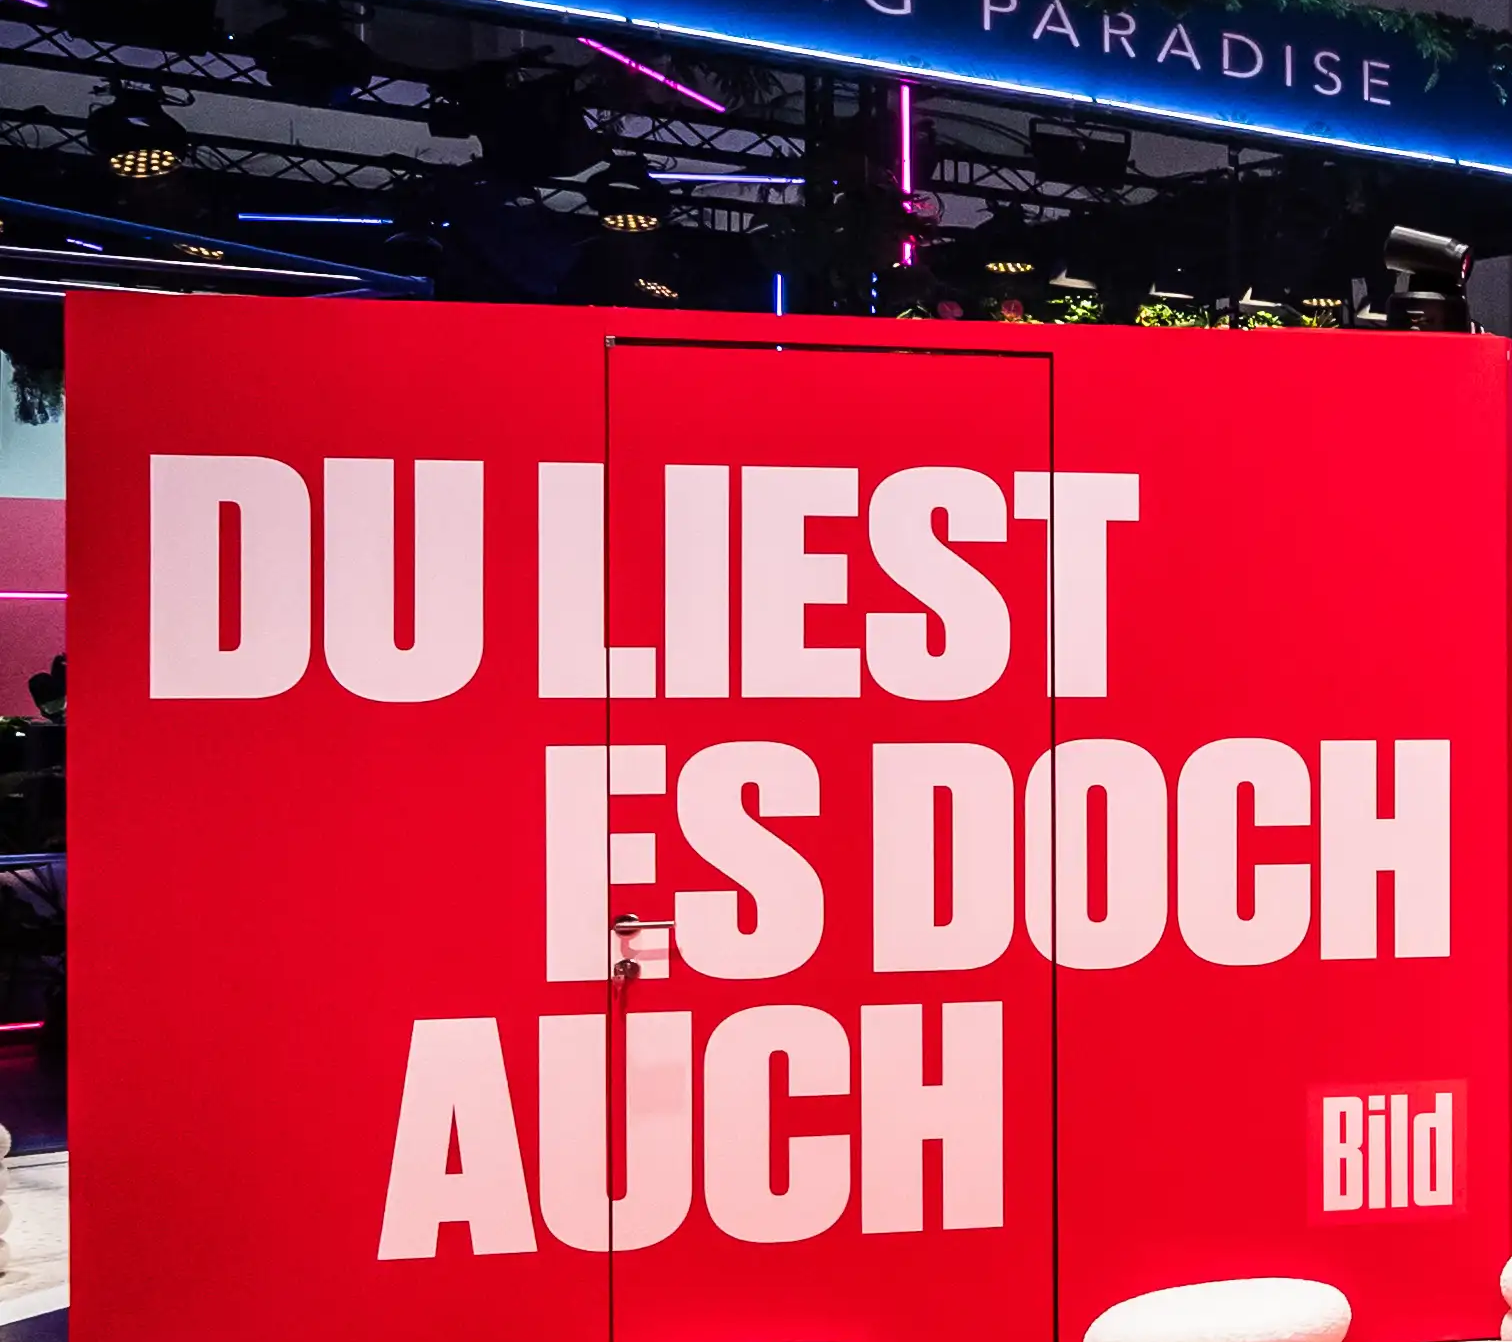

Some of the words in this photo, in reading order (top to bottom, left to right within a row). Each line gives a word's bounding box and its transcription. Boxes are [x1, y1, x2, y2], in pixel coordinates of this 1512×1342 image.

[149, 454, 485, 703] DU
[537, 460, 1140, 703] LIEST
[545, 741, 824, 983] ES
[872, 737, 1452, 974] DOCH
[379, 1000, 1004, 1261] AUCH
[1322, 1092, 1453, 1212] Bild
